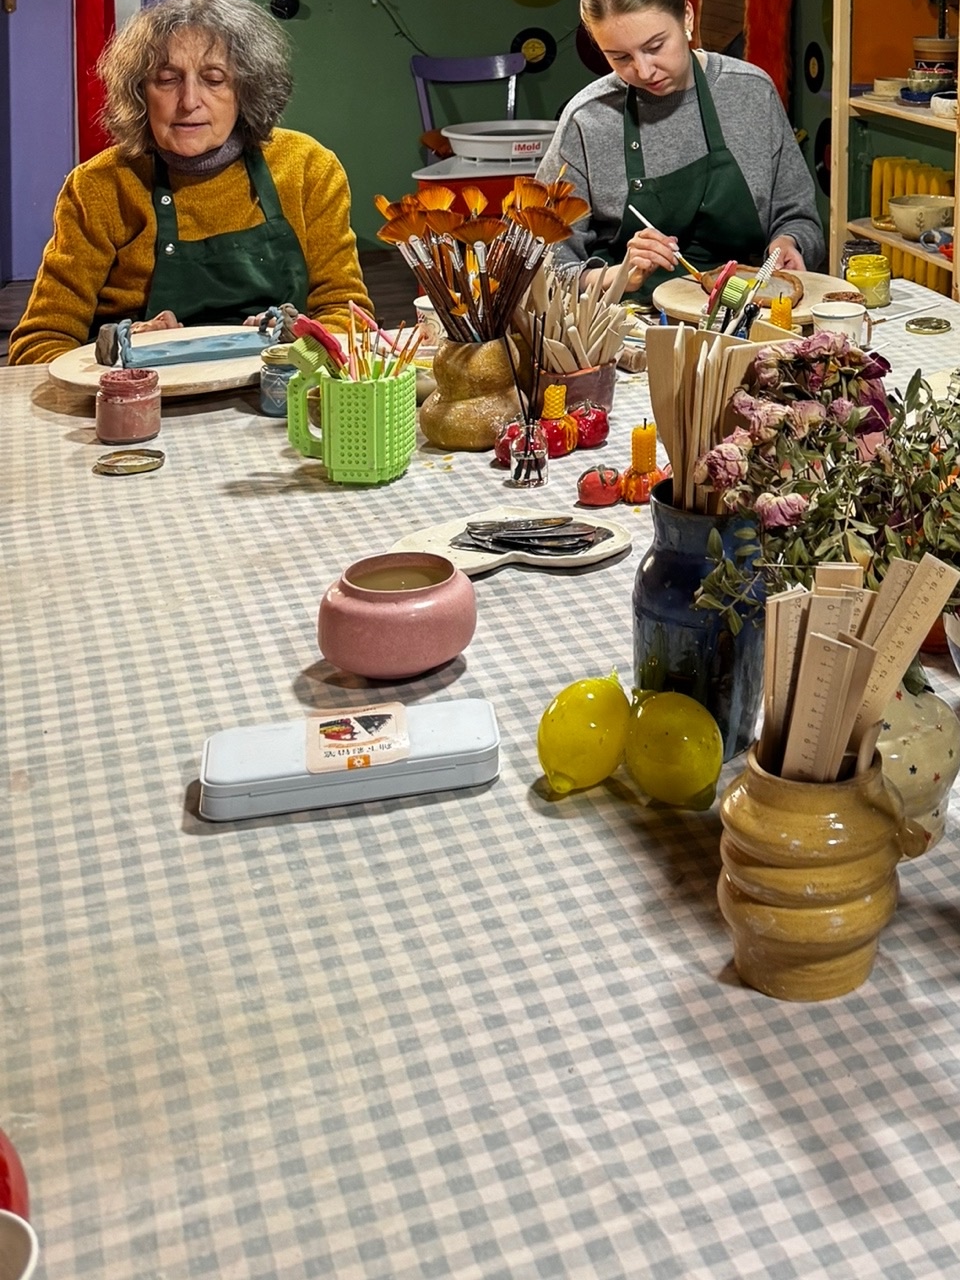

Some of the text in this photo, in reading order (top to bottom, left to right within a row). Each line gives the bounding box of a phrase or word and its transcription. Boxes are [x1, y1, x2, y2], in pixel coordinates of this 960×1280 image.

[514, 141, 541, 151] iMold
[936, 566, 946, 579] 20
[929, 581, 938, 591] 19
[850, 591, 865, 634] 20 19 18
[913, 611, 921, 620] 17
[904, 626, 913, 635] 16
[887, 655, 896, 664] 14
[879, 670, 888, 679] 13
[871, 684, 879, 694] 12
[862, 700, 871, 709] 11
